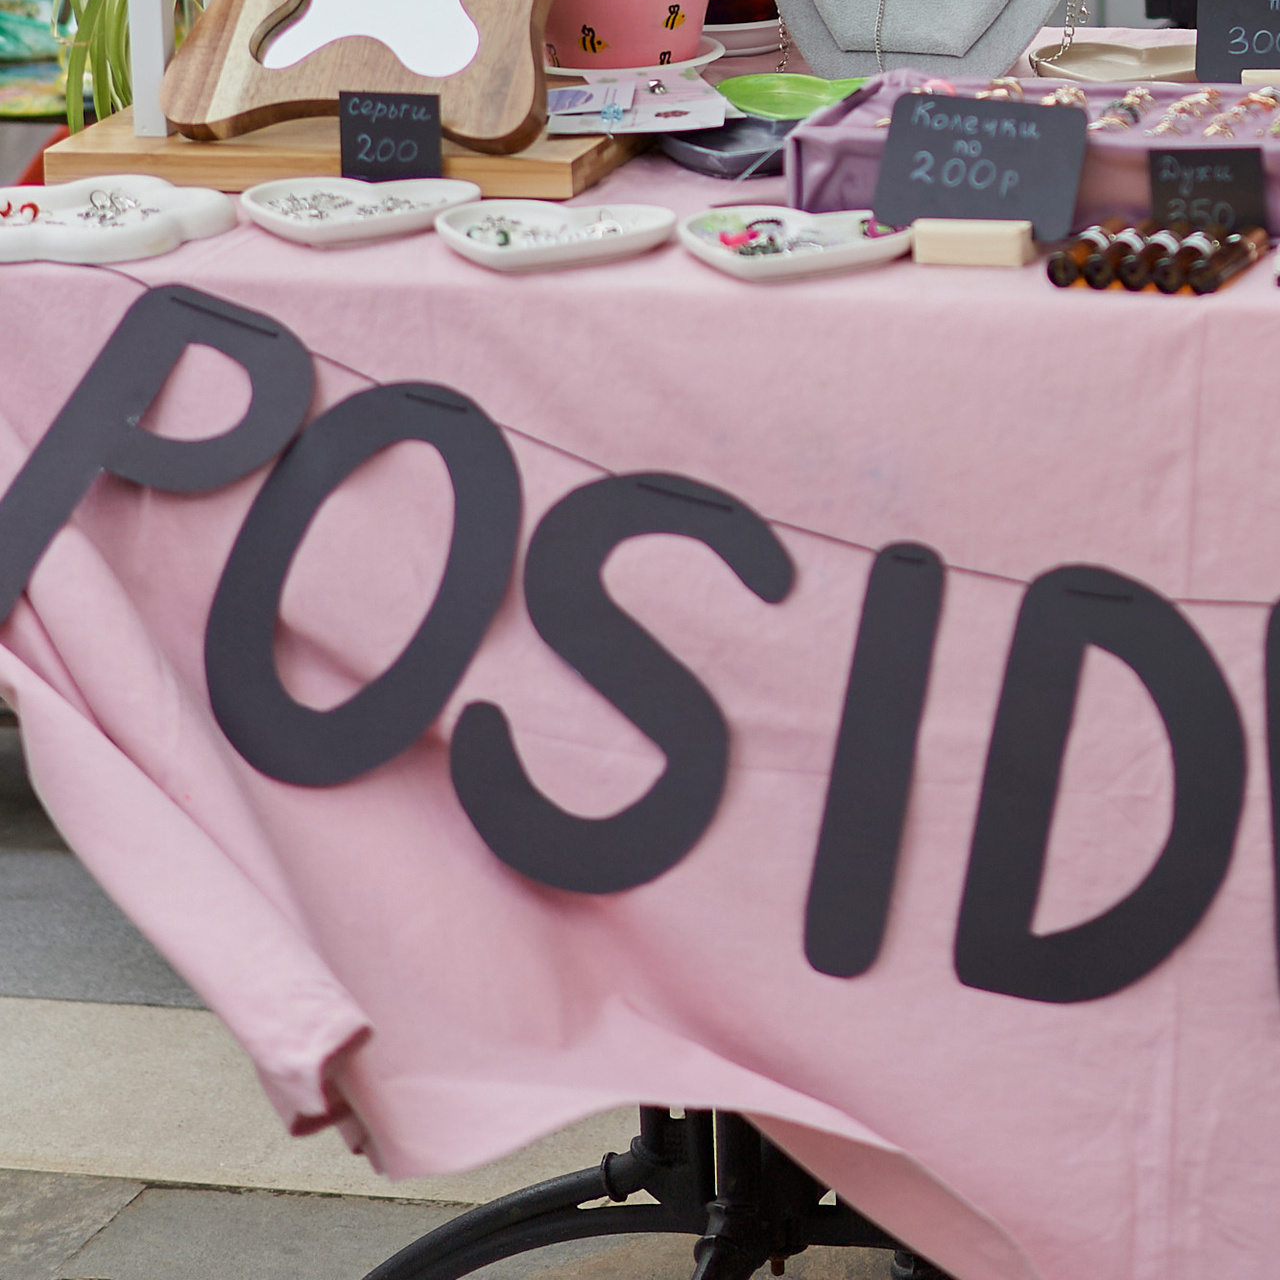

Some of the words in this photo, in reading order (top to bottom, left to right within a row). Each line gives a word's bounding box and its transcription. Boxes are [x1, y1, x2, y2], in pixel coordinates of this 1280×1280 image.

[911, 99, 1041, 139] Колечки
[356, 133, 418, 163] 200
[952, 139, 982, 158] по
